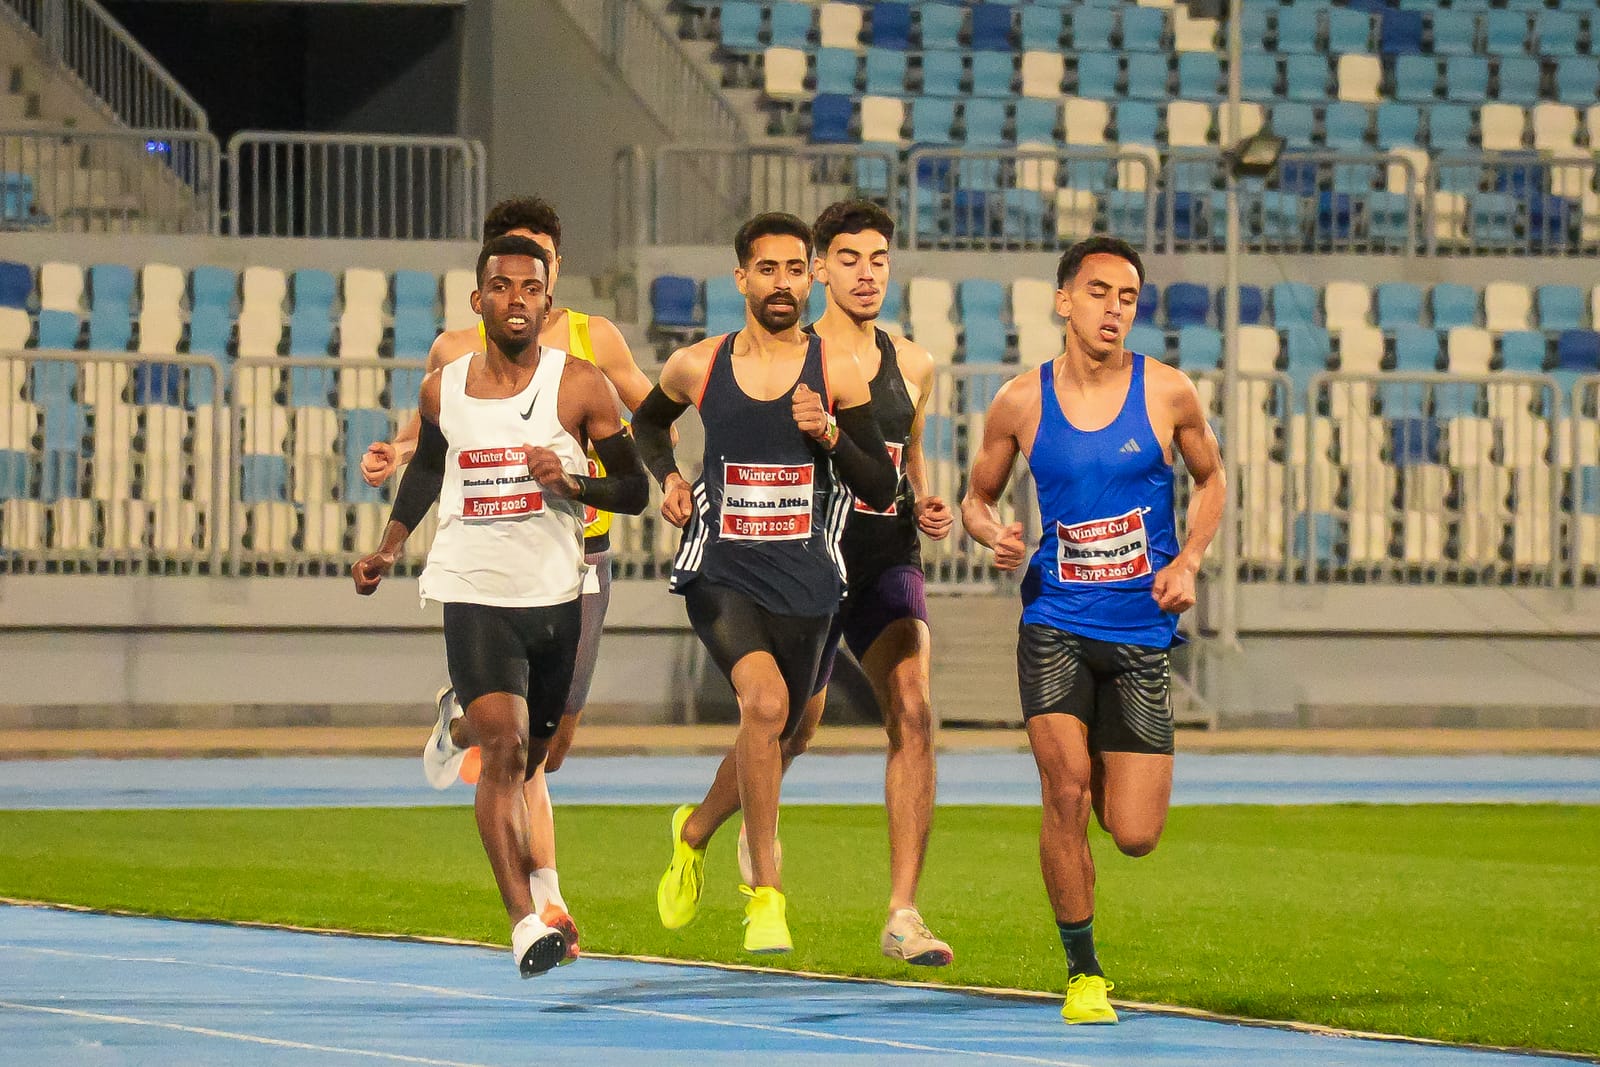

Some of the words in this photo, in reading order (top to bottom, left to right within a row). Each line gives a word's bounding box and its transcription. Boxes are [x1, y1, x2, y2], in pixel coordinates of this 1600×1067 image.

[468, 451, 503, 464] Winter
[504, 449, 526, 463] Cup
[738, 468, 776, 481] Winter
[777, 469, 800, 484] Cup
[473, 500, 500, 516] Egypt
[501, 496, 527, 511] 2026
[726, 496, 776, 508] Salman
[778, 498, 809, 508] Attia
[735, 518, 767, 535] Egypt
[769, 518, 796, 531] 2026
[1068, 526, 1107, 540] Winter
[1108, 520, 1129, 534] Cup
[1063, 540, 1142, 559] Marwan
[1074, 565, 1106, 581] Egypt
[1108, 562, 1134, 577] 2026
